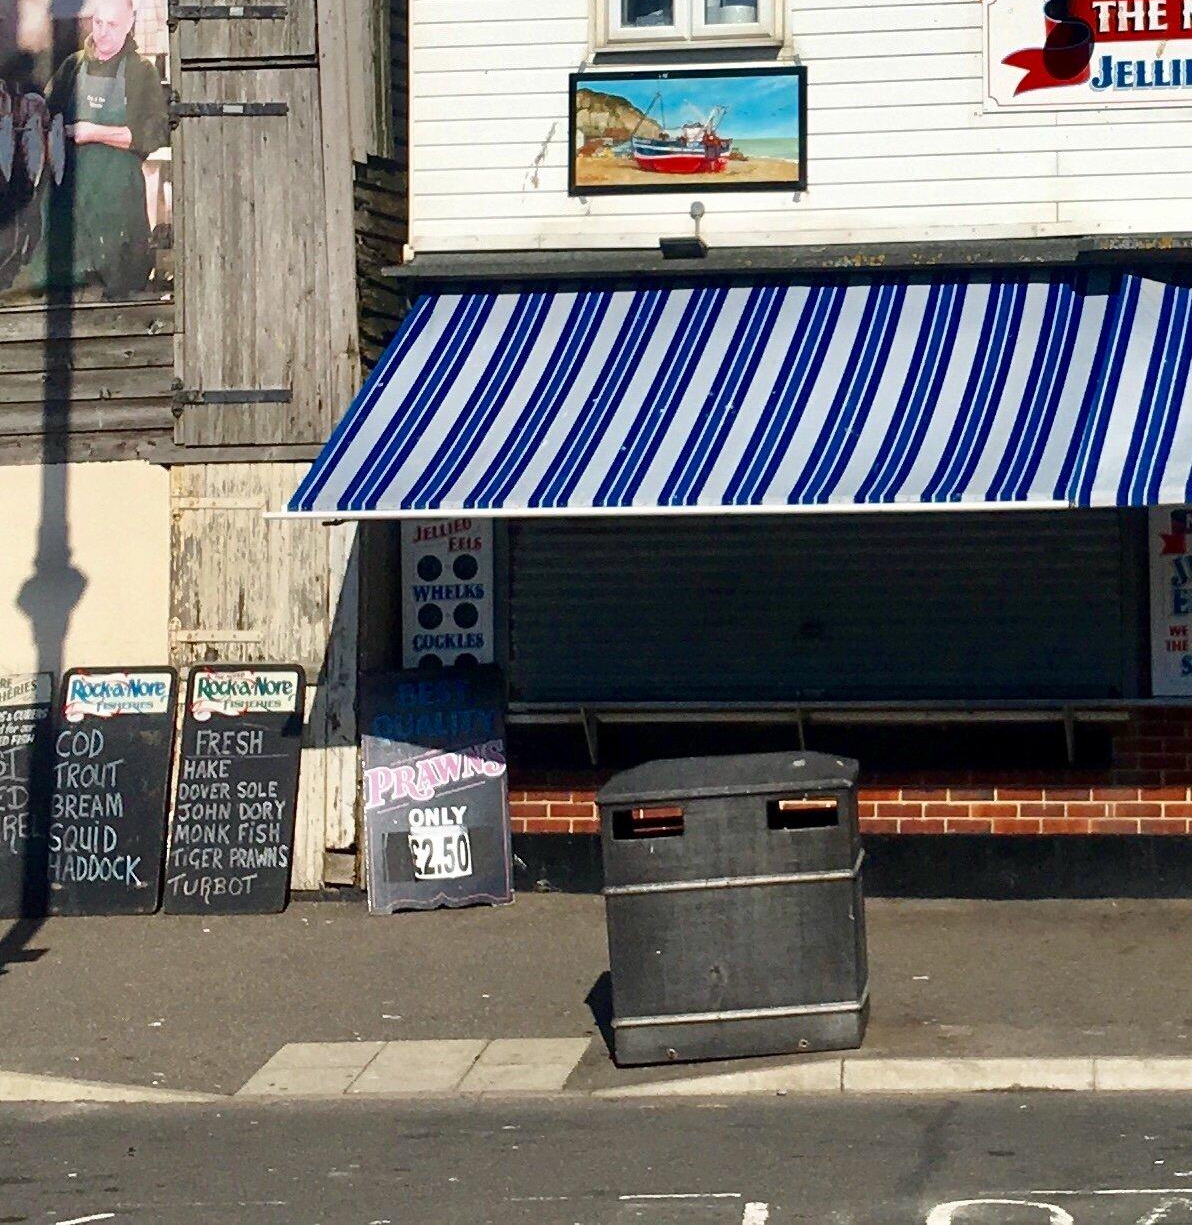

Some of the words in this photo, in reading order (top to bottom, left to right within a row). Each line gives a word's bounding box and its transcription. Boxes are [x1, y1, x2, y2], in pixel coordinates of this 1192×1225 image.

[413, 519, 472, 544] JELLIED
[450, 536, 482, 552] EELS
[413, 583, 485, 602] WHELKS
[412, 633, 485, 651] COCKLES
[1169, 625, 1188, 636] WE
[1166, 639, 1188, 651] THE
[96, 701, 154, 712] FISHERIES
[223, 699, 282, 711] FISHERIES
[373, 710, 495, 737] QUALITY
[56, 728, 104, 758] COD
[196, 730, 264, 755] FRESH
[54, 758, 124, 788] TROUT
[183, 759, 231, 779] HAKE
[364, 739, 507, 809] PRAWNS
[178, 782, 231, 800] DOVER
[236, 781, 278, 799] SOLE
[51, 792, 124, 820] BREAM
[178, 802, 231, 822] JOHN
[239, 799, 286, 820] DORY
[408, 805, 468, 826] ONLY
[48, 820, 118, 854] SQUID
[174, 823, 231, 845] MONK
[237, 821, 281, 844] FISH
[171, 846, 223, 870] TIGER
[229, 844, 289, 868] PRAWNS
[410, 834, 470, 876] £2.50
[47, 854, 142, 886] HADDOCK
[167, 873, 258, 905] TURBOT
